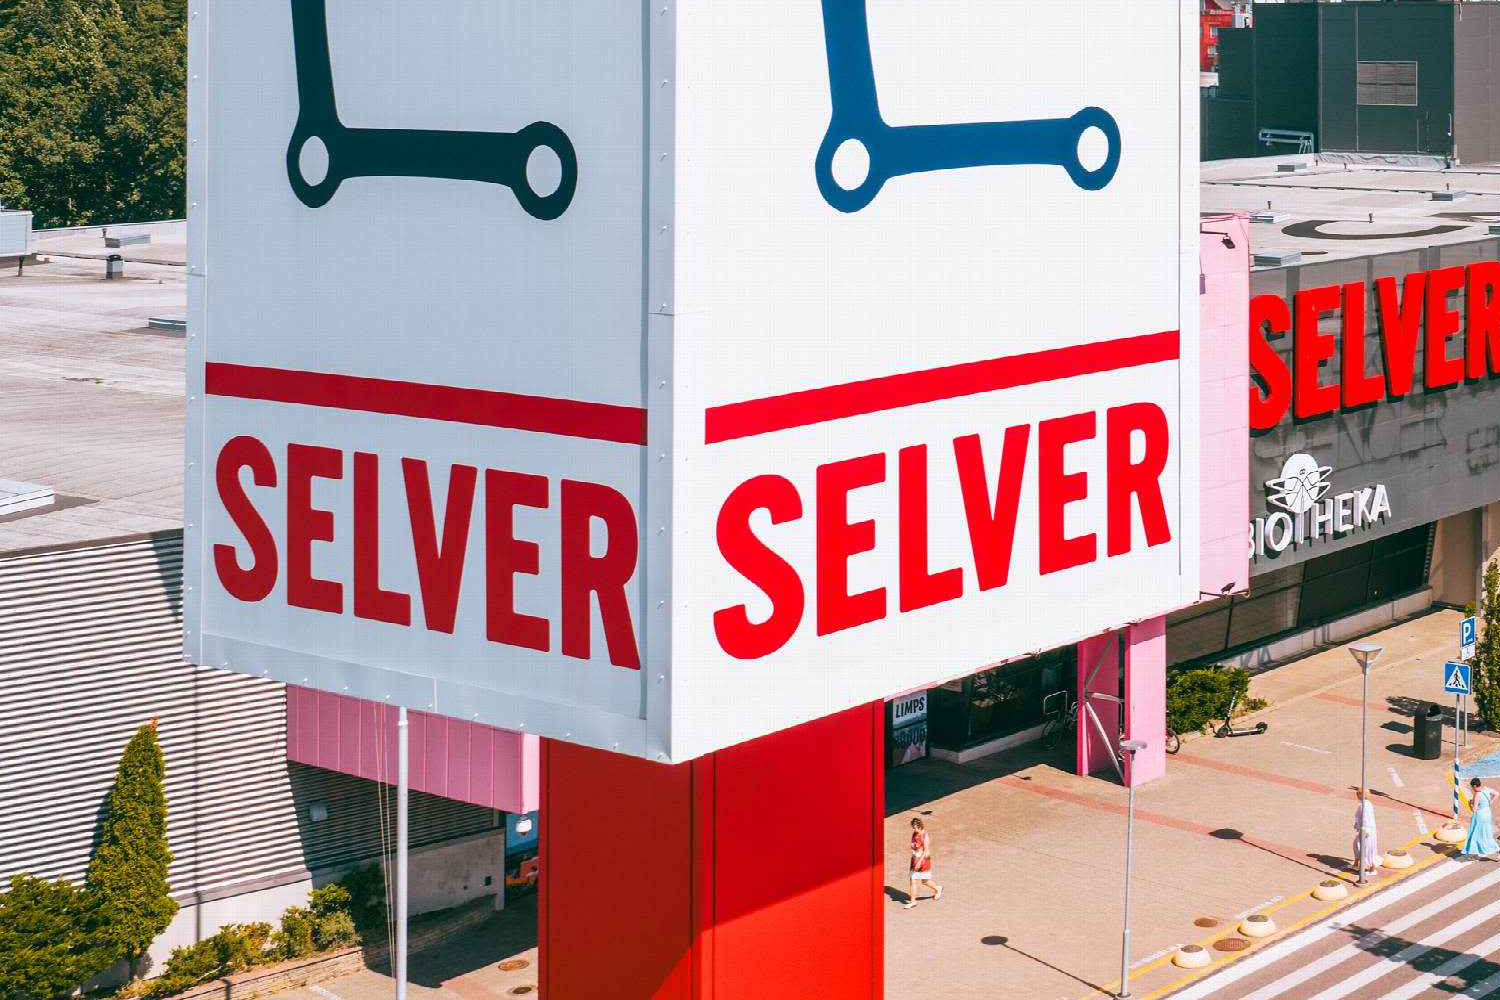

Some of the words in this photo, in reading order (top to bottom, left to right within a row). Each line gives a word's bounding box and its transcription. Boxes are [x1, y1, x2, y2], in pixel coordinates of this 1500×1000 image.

[214, 436, 640, 670] SELVER
[713, 402, 1172, 660] SELVER
[895, 696, 925, 718] LIMPS
